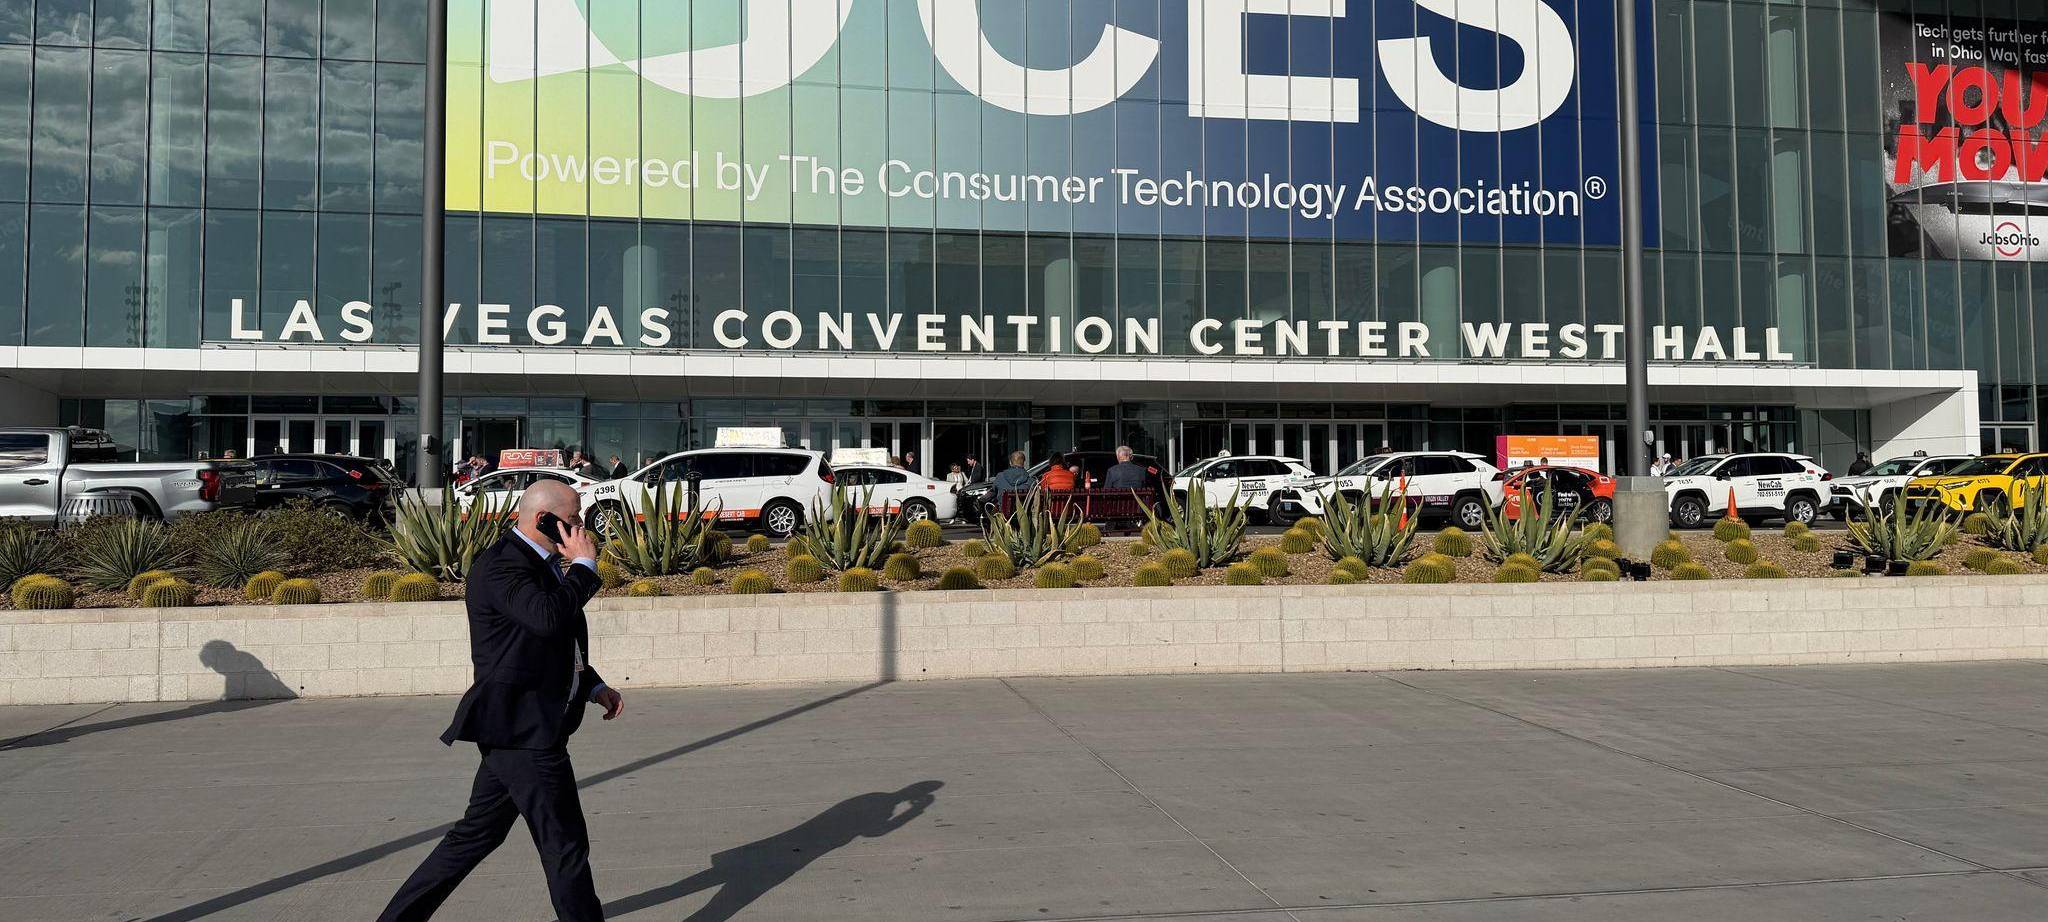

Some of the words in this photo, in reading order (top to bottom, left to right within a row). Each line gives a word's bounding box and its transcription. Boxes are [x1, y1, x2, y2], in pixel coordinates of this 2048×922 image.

[1916, 23, 1950, 39] Tech
[1953, 28, 1984, 42] gets
[1987, 26, 2038, 44] further
[1931, 43, 1945, 58] in
[1990, 47, 2019, 66] Way
[2024, 49, 2048, 64] fas
[488, 140, 699, 189] Powered
[716, 151, 770, 201] by
[778, 154, 866, 197] The
[877, 159, 1104, 203] Consumer
[1111, 168, 1347, 220] Technology
[1979, 232, 2040, 247] JobsOhio
[230, 298, 374, 342] LAS
[712, 309, 1159, 355] CONVENTION
[1189, 318, 1432, 358] CENTER
[1461, 322, 1624, 360] WEST
[1653, 325, 1794, 361] HALL
[594, 485, 616, 495] 4398
[1758, 480, 1783, 489] NewCab
